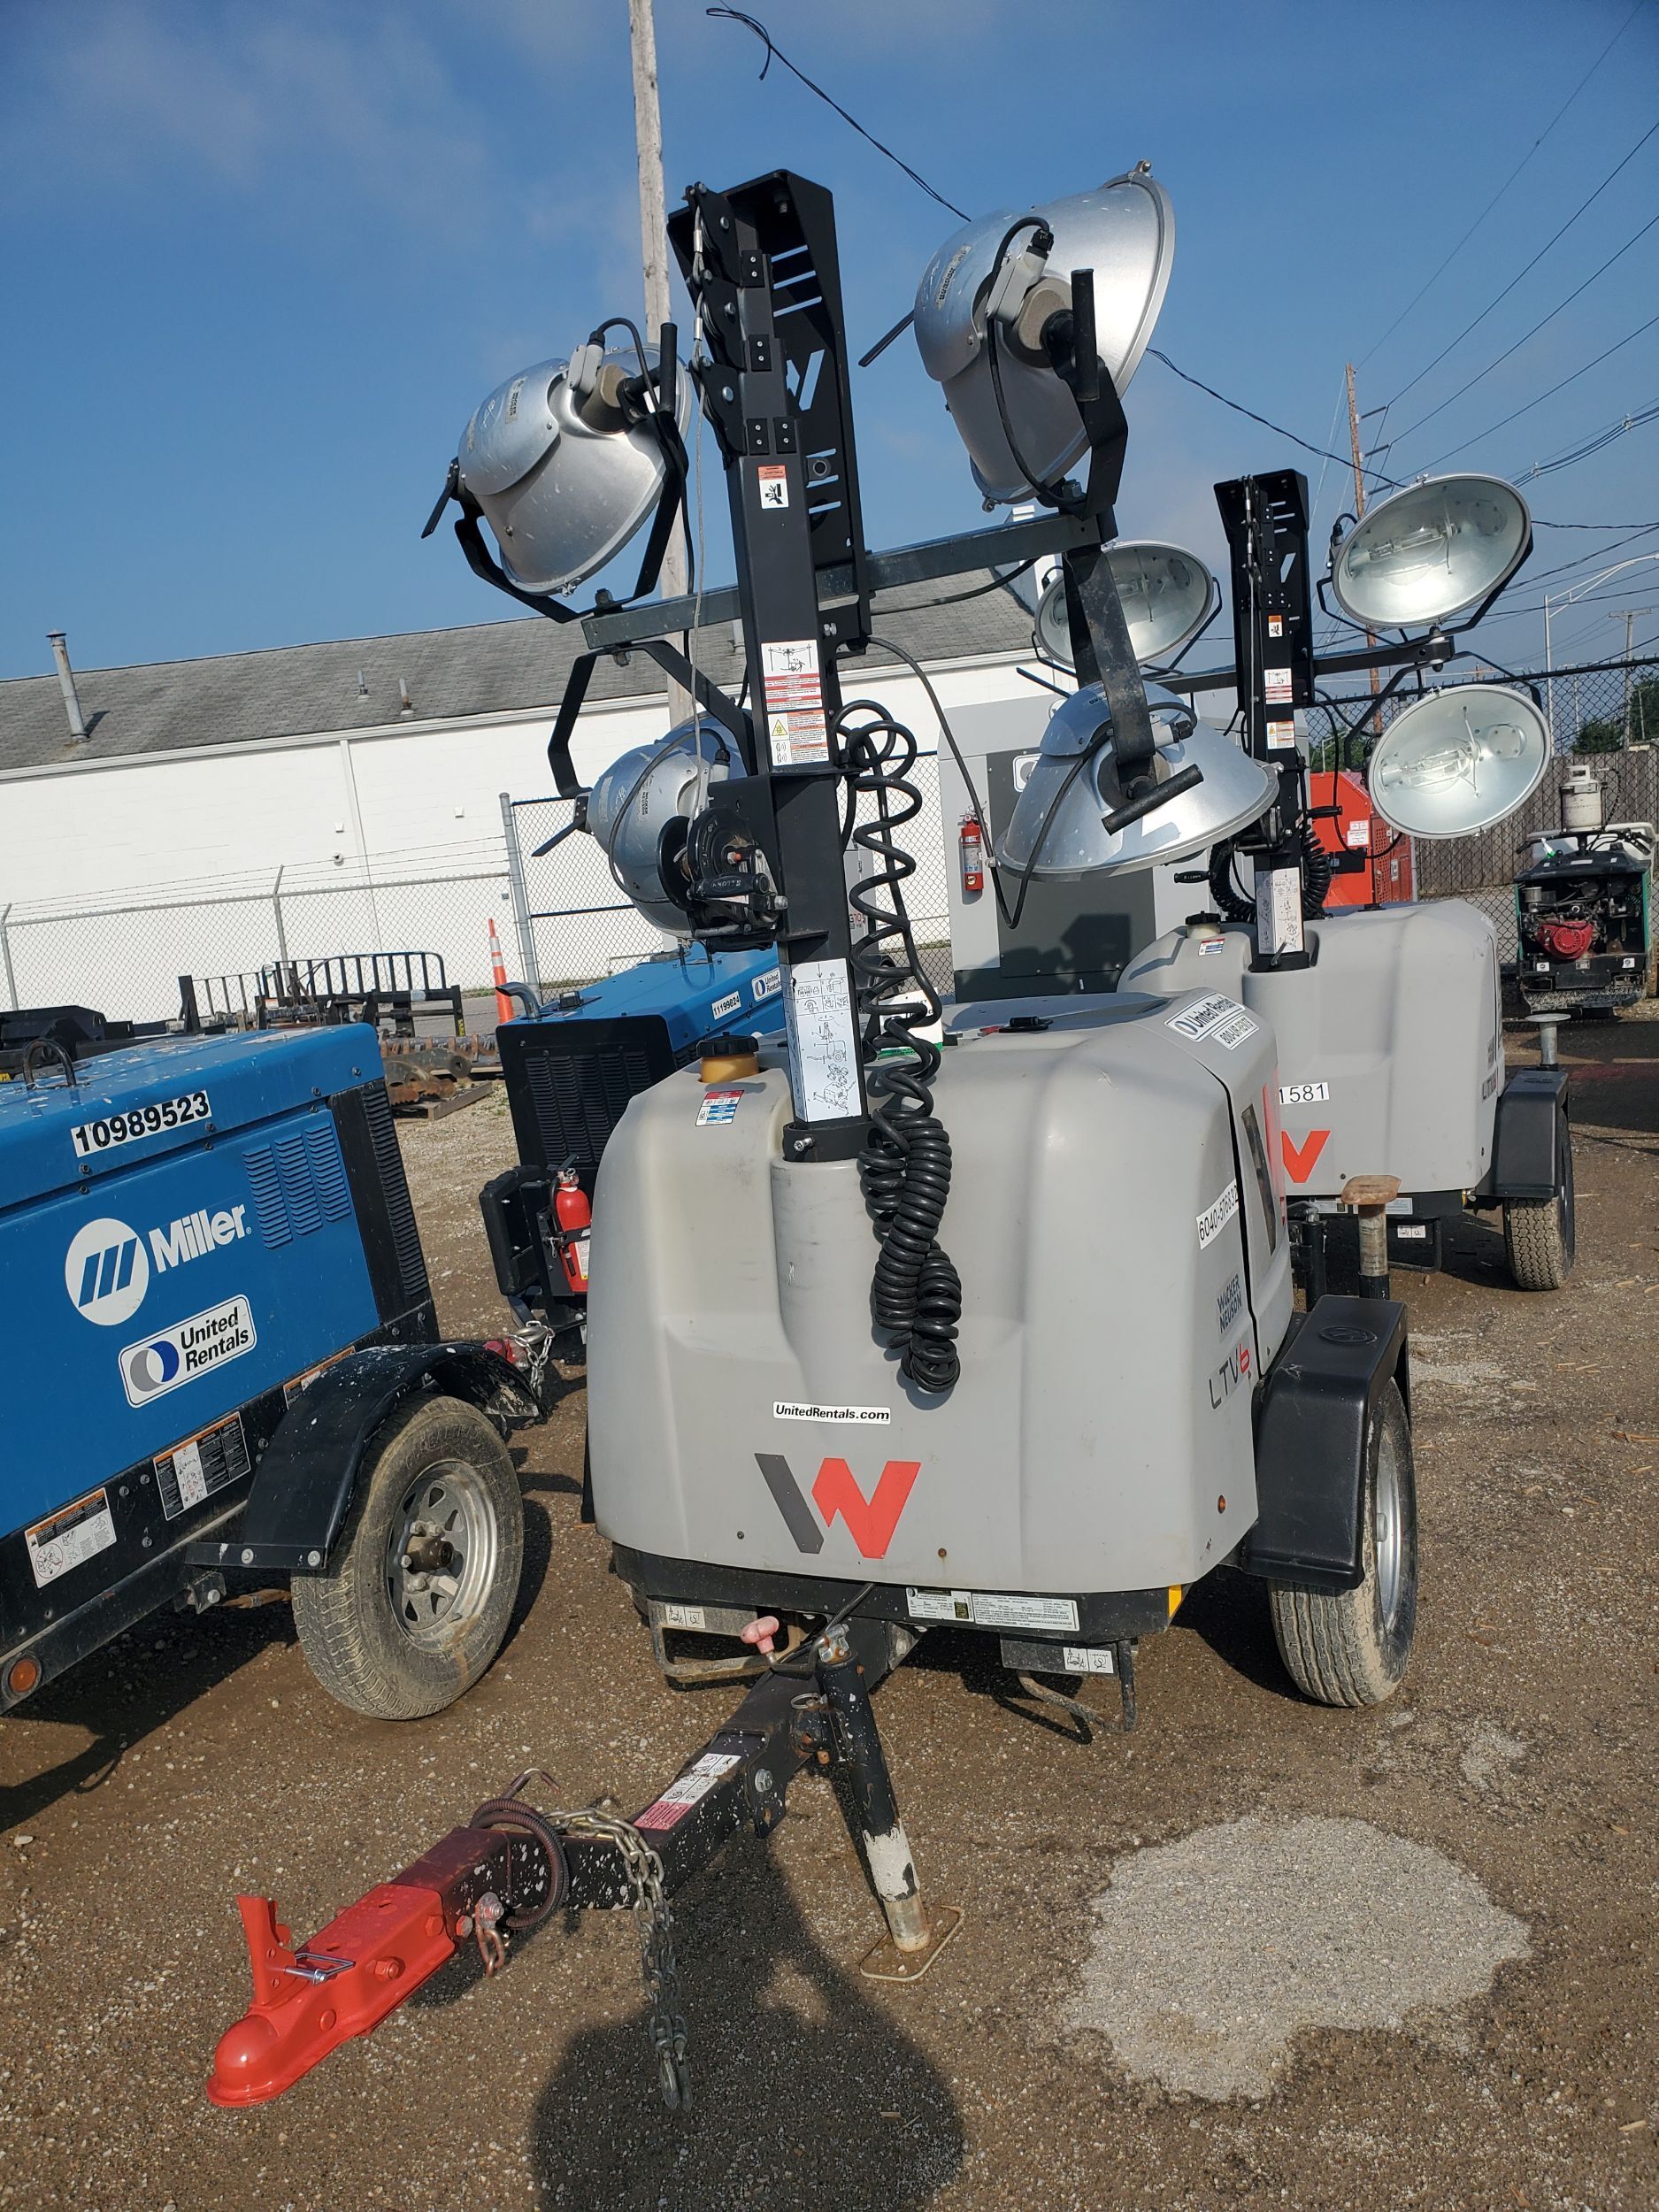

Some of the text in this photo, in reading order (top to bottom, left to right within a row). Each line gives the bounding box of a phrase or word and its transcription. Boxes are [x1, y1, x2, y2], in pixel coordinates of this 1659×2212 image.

[76, 1092, 210, 1152] 10989523
[149, 1203, 246, 1274] Miller
[1217, 1273, 1240, 1315] WACKER
[1219, 1294, 1242, 1334] NEUSON
[180, 1306, 239, 1350] United
[185, 1327, 250, 1372] Rentals
[775, 1403, 890, 1420] UnitedRentals.com
